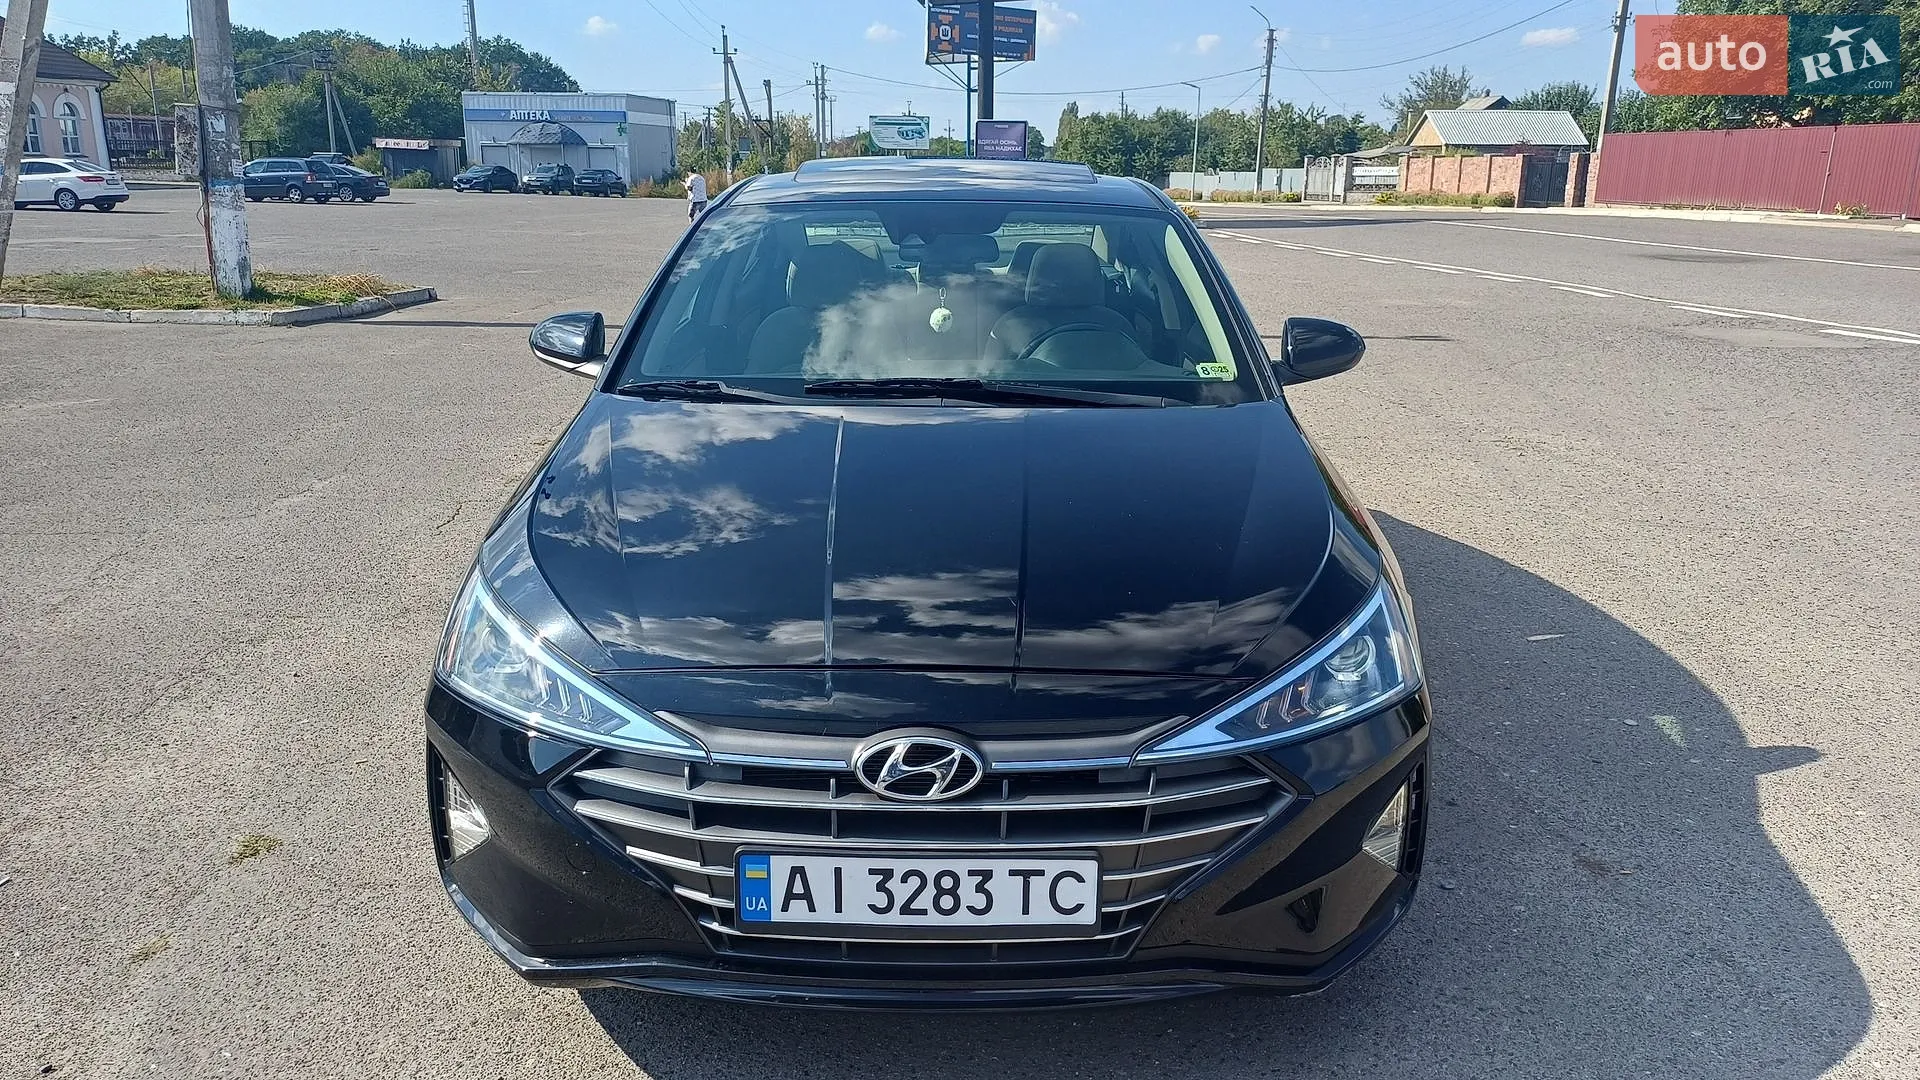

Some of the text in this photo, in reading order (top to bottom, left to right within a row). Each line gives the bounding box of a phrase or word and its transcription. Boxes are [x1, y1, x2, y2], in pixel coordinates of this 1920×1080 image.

[509, 110, 551, 121] АПТЕКА
[1201, 366, 1210, 376] 8
[780, 865, 1086, 917] AI 3283 TC
[745, 896, 768, 911] UA
